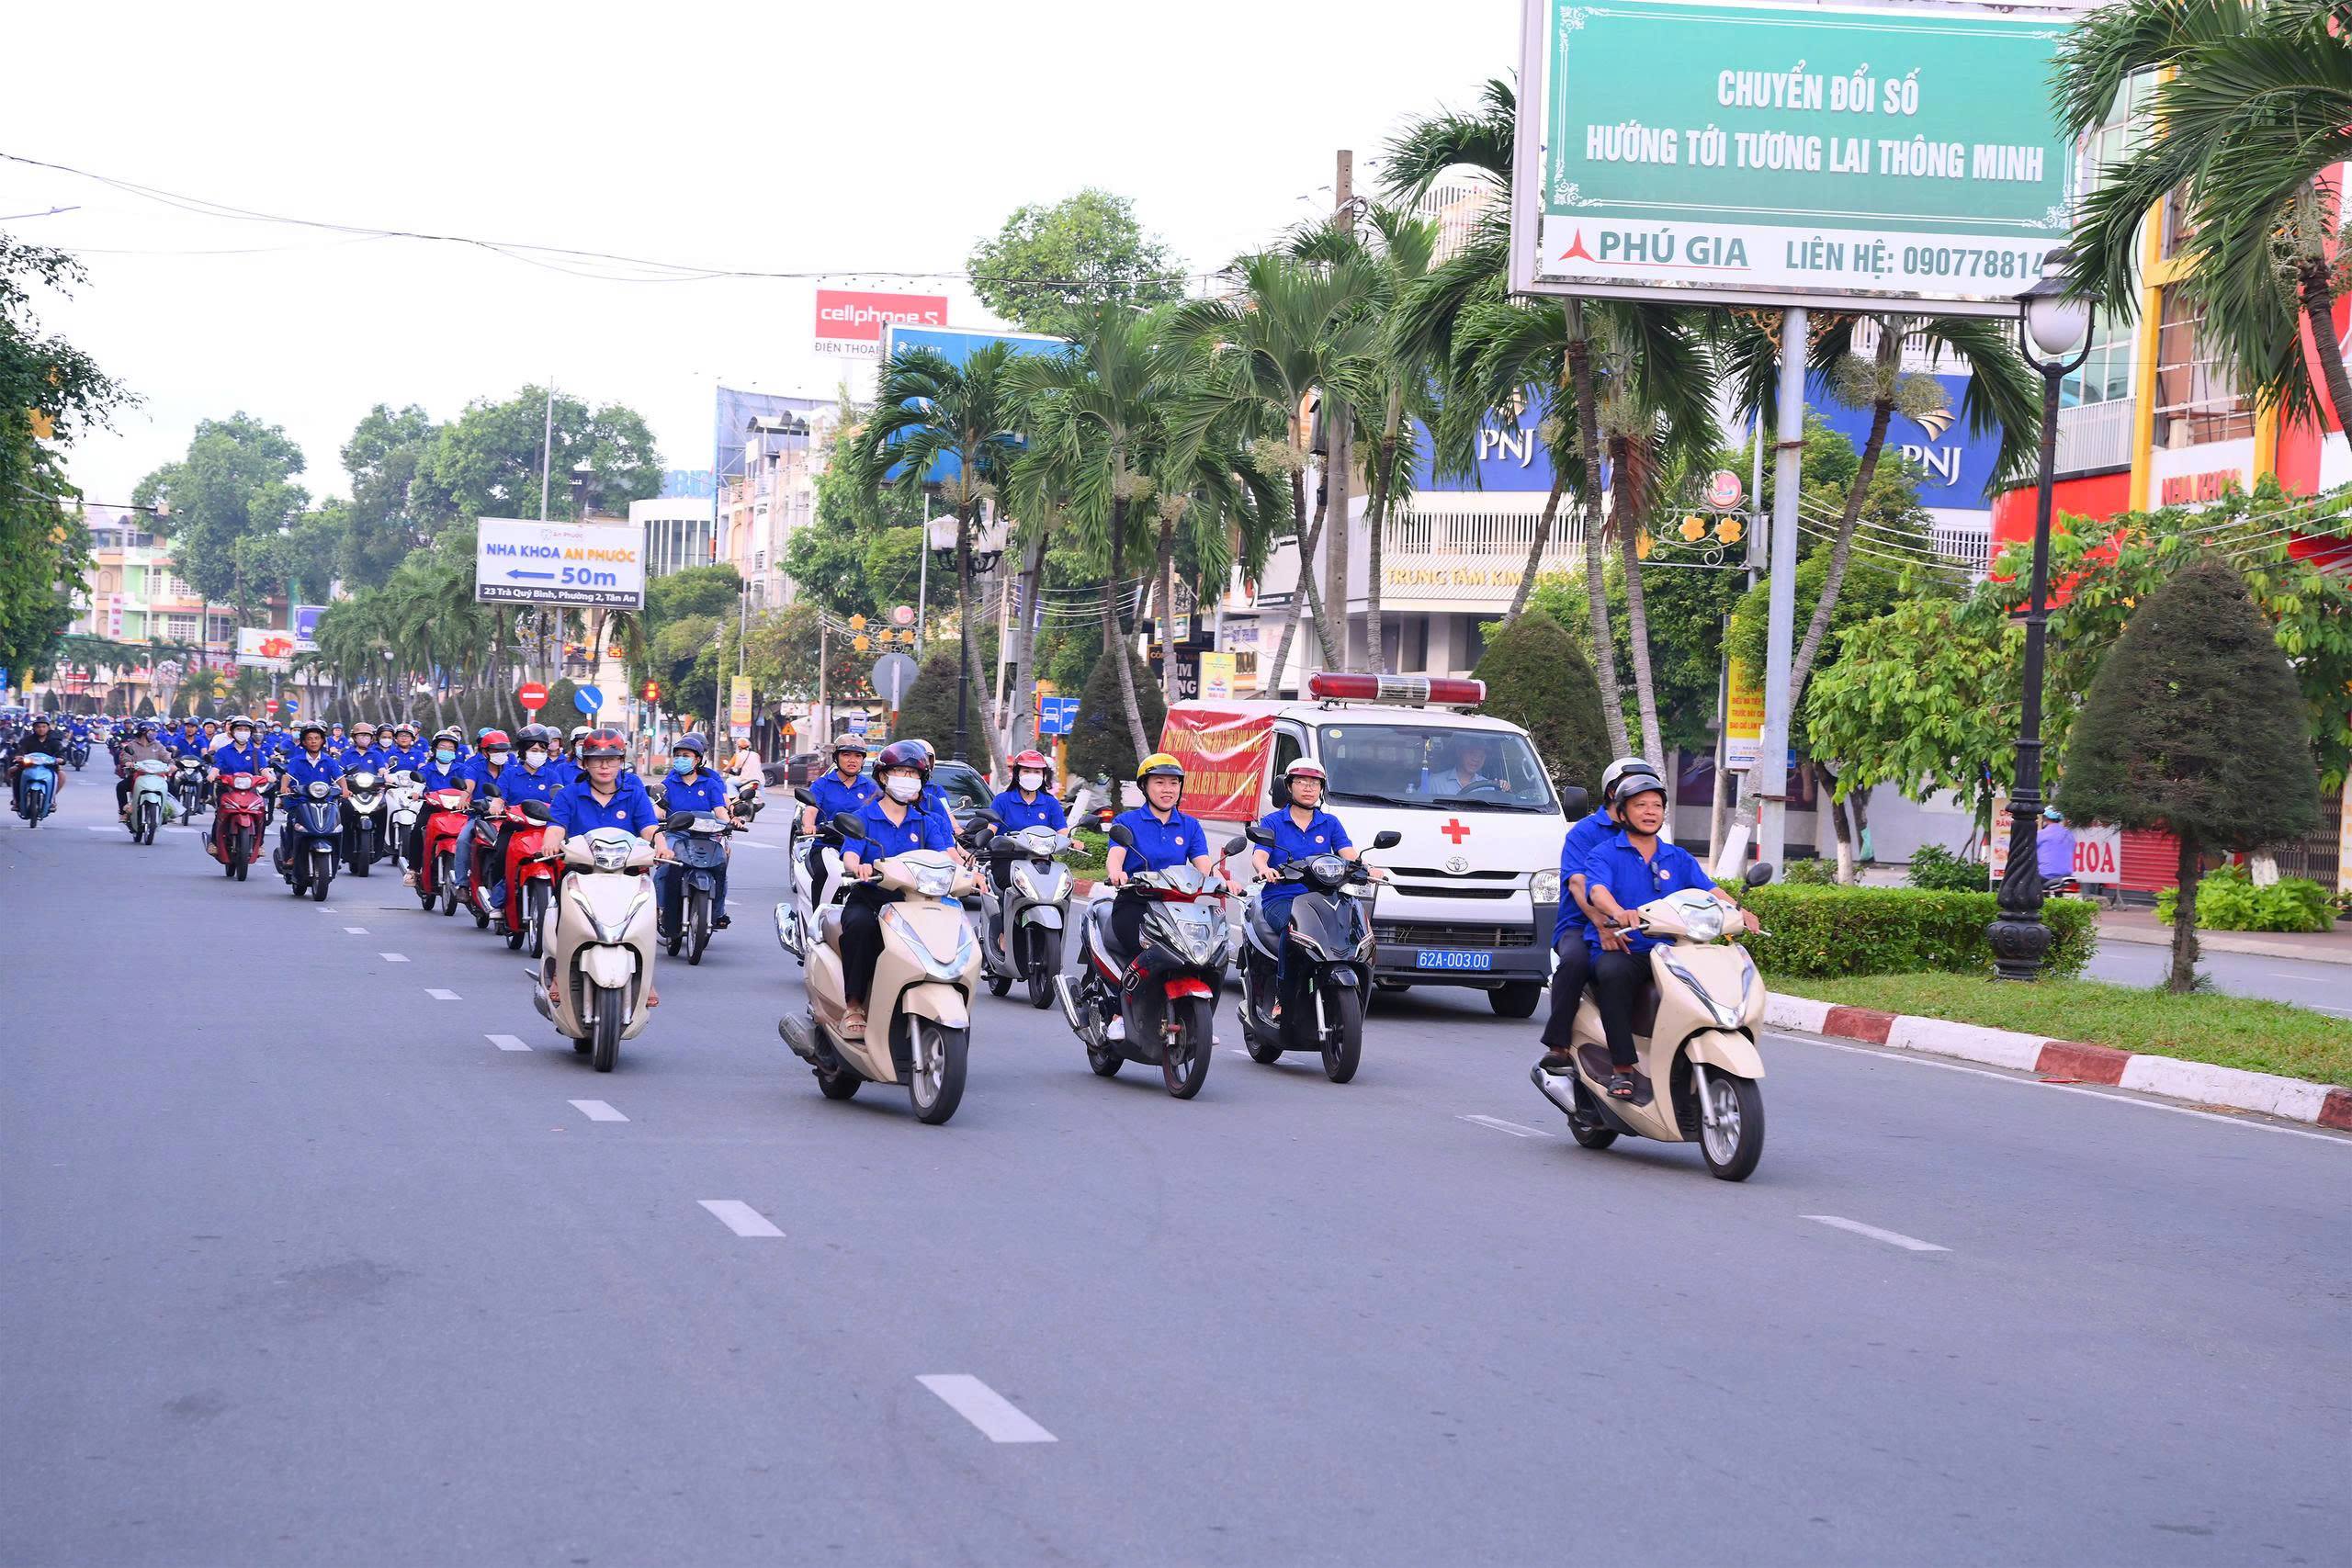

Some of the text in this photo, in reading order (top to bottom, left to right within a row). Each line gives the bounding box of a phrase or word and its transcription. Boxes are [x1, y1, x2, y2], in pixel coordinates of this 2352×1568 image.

[1717, 59, 1921, 117] CHUYỂN ĐỔI SỐ
[1586, 119, 2044, 182] HƯỚNG TỚI TƯƠNG LAI THÔNG MINH
[1600, 227, 1748, 267] PHÚ GIA
[1785, 235, 1845, 273] LIÊN
[1854, 239, 1894, 280] HỆ:
[814, 341, 842, 354] ĐIỆN
[1478, 429, 1535, 468] PNJ
[1902, 445, 1962, 486] PNJ
[2161, 475, 2193, 506] NHA
[486, 544, 636, 563] NHA KHOA AN PHƯỚC
[560, 567, 616, 586] 50m
[1385, 568, 1447, 585] TRUNG
[1451, 568, 1486, 586] TÂM
[1490, 570, 1522, 586] KIM
[497, 588, 512, 596] Trà
[558, 592, 594, 603] Phường
[605, 592, 621, 603] Tân
[622, 594, 636, 603] An
